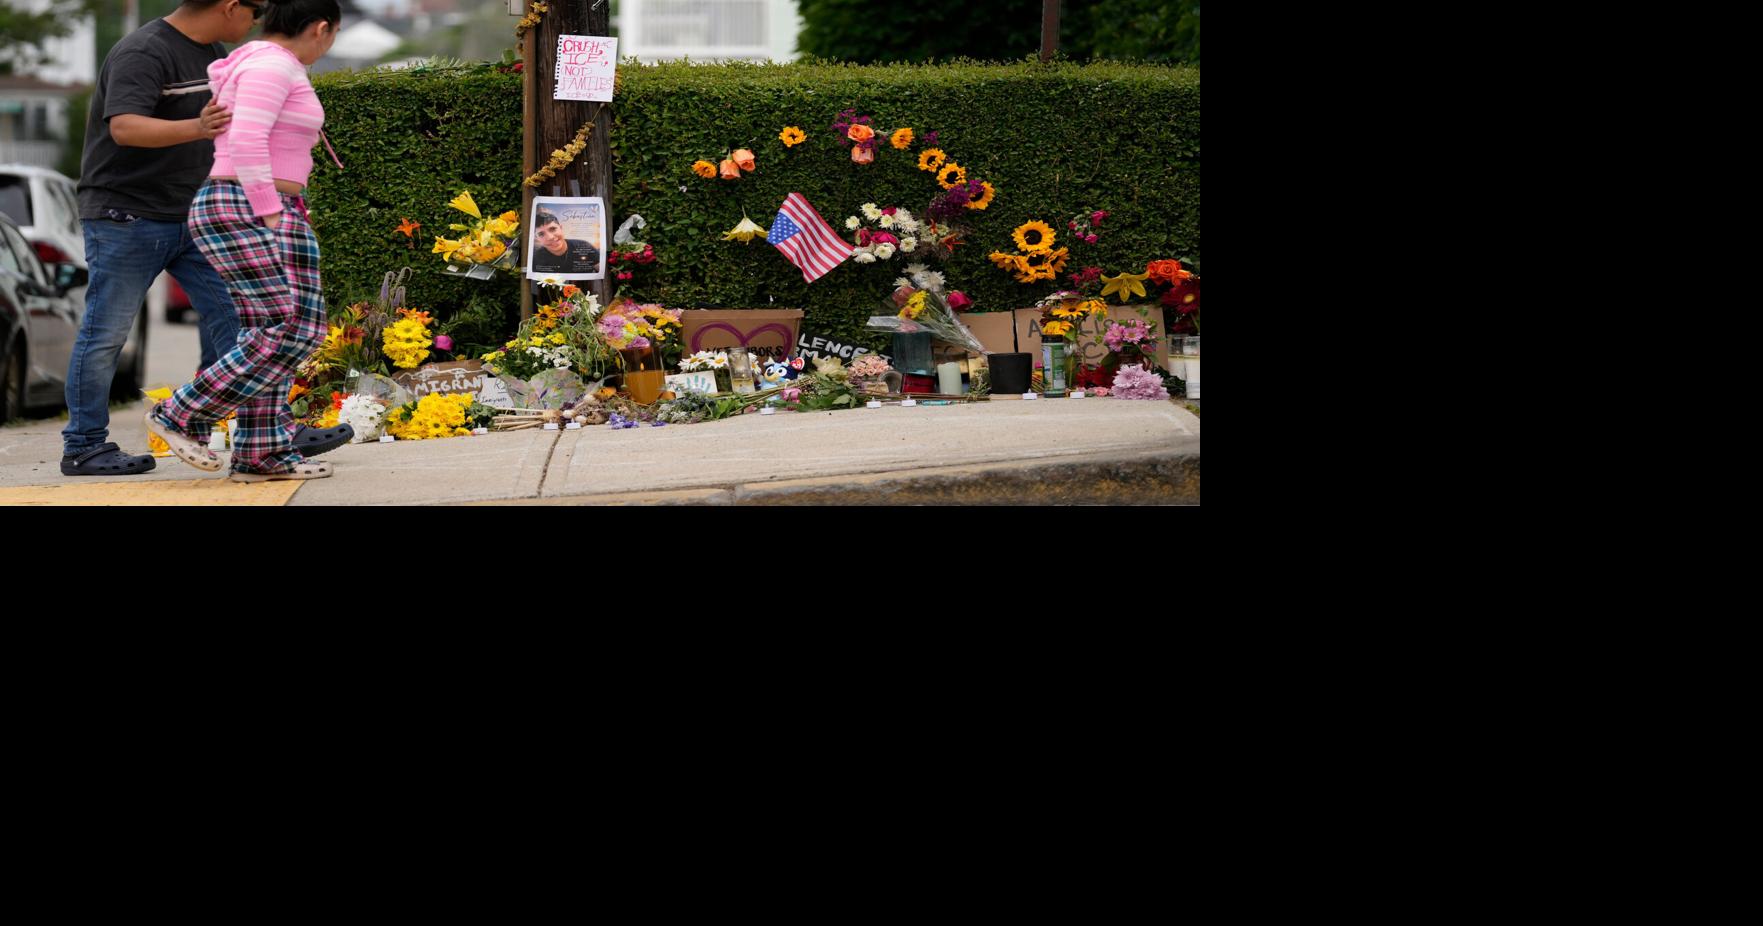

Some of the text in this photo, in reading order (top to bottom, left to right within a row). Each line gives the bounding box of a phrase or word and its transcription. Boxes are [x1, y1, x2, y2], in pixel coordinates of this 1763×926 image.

[563, 39, 600, 53] CRUSH
[564, 52, 601, 65] ICE
[564, 66, 591, 77] NOT
